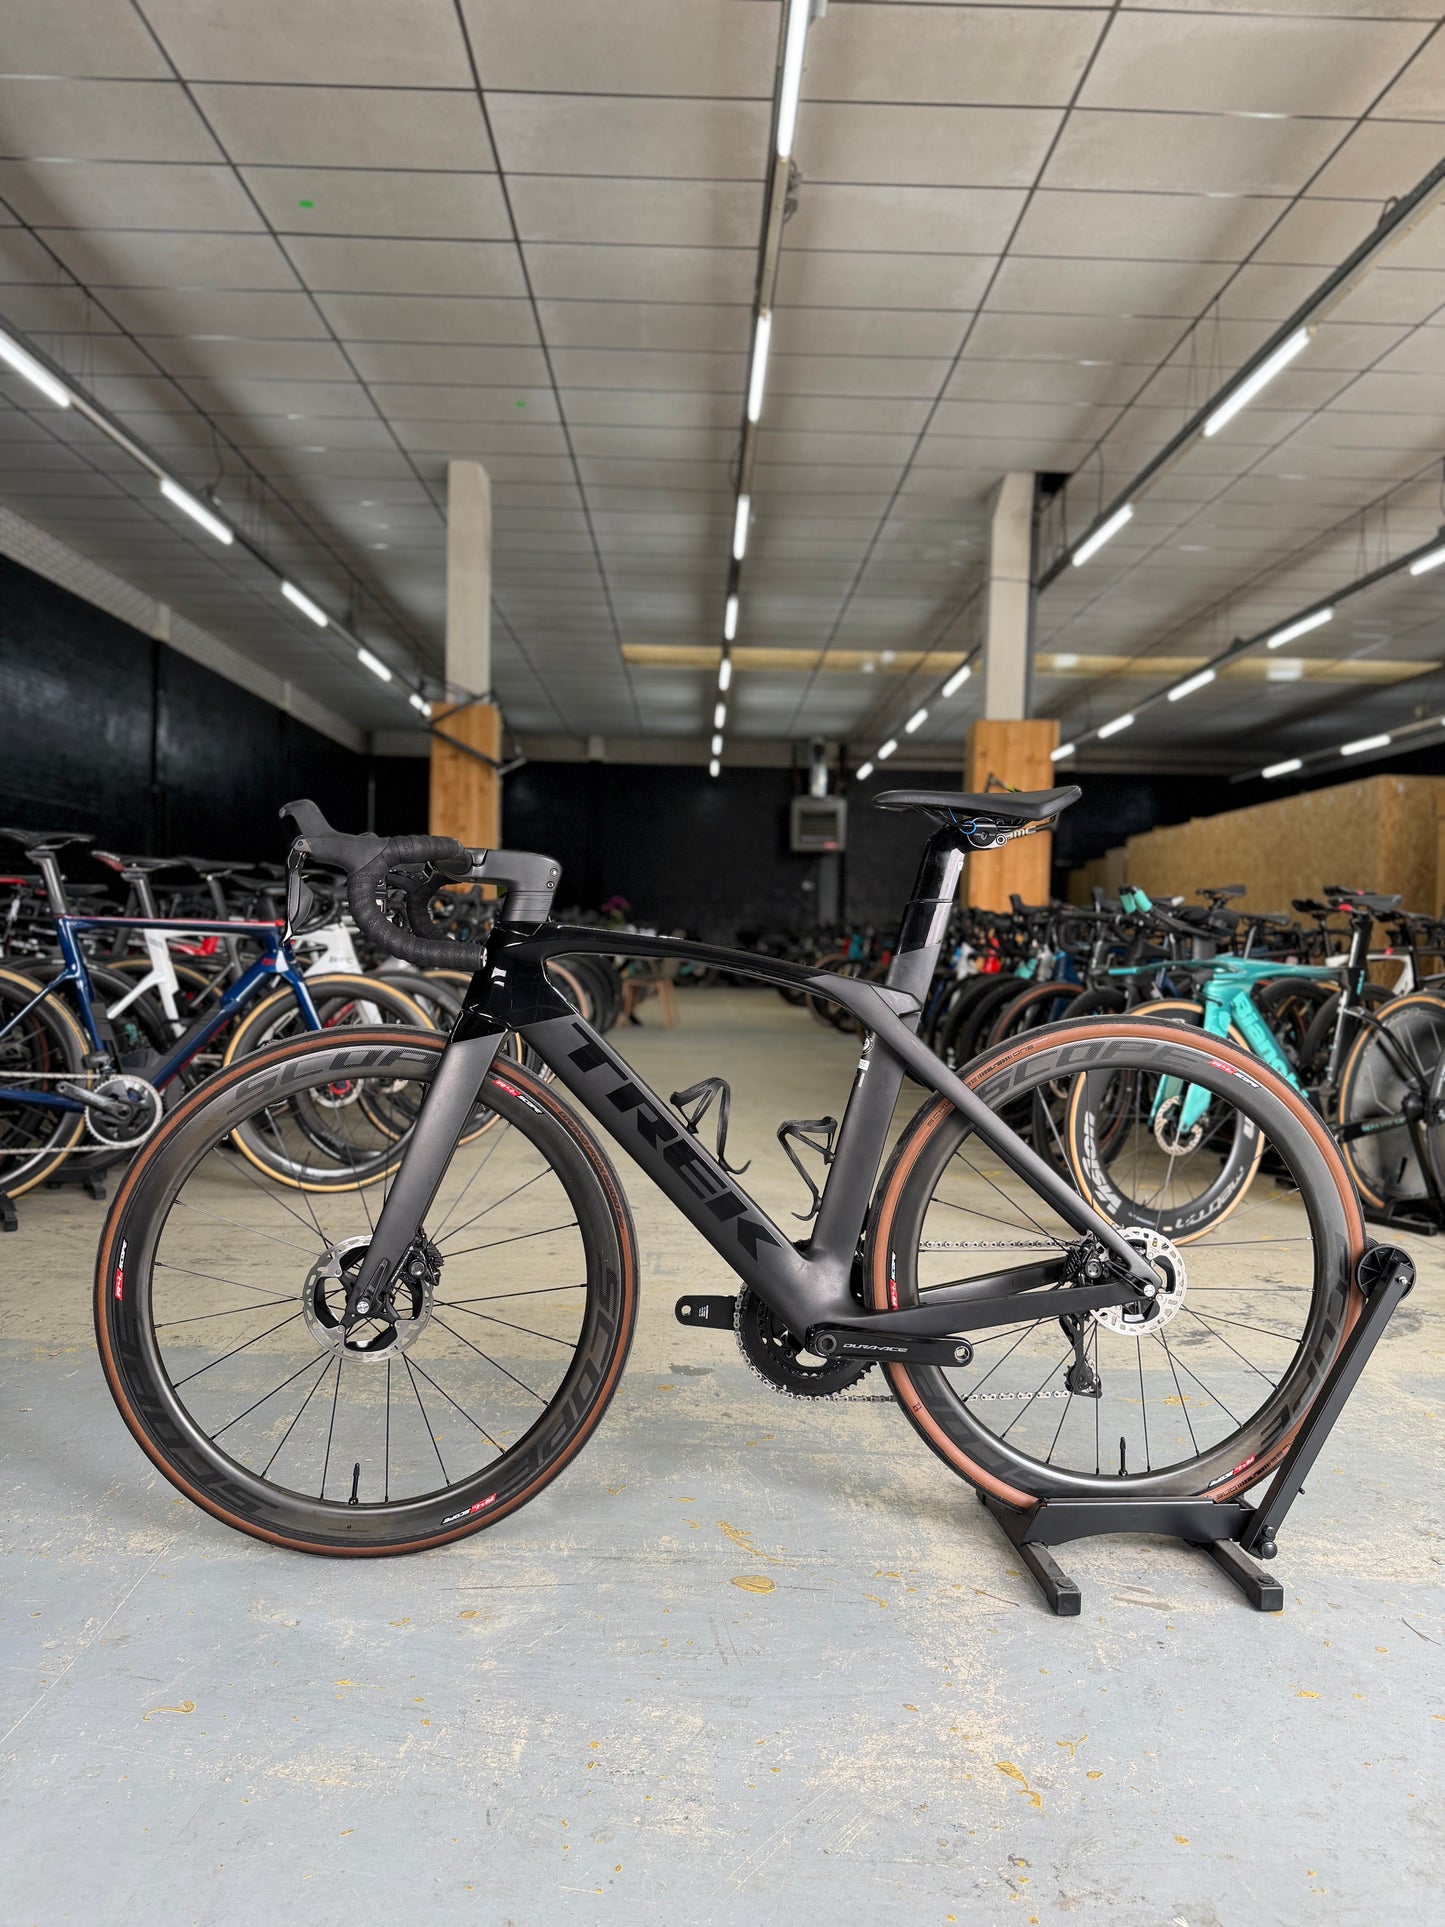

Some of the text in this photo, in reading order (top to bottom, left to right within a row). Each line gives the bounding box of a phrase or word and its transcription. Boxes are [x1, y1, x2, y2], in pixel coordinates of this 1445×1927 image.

[227, 1050, 441, 1115] SCOP
[567, 1022, 784, 1262] TREK
[118, 1240, 128, 1270] SCOPE
[843, 1343, 908, 1353] DURA-ACE
